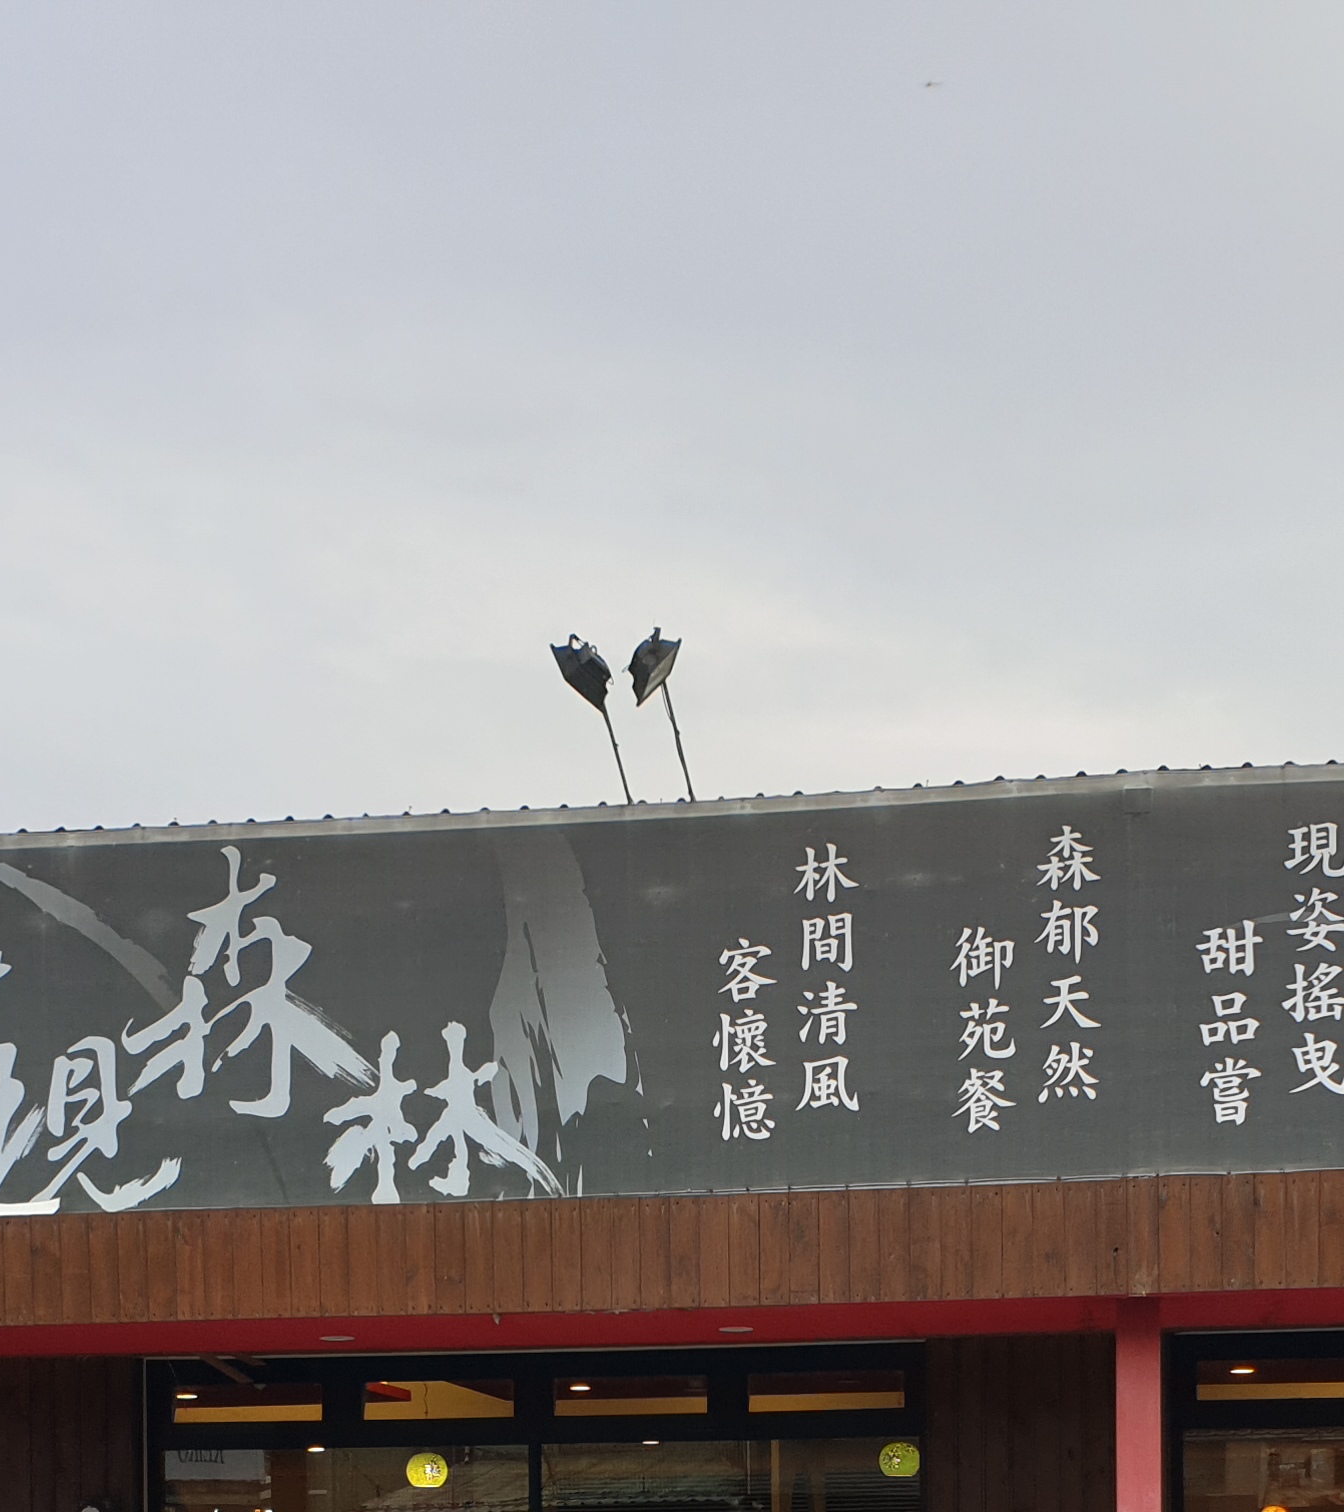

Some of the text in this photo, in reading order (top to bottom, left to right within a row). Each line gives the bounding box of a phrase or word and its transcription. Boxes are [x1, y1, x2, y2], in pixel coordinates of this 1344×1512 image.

[712, 938, 777, 1141] 客懷憶
[794, 843, 860, 1111] 林間清風
[950, 926, 1016, 1134] 御苑餐
[1034, 825, 1102, 1103] 森郁天然
[1195, 919, 1263, 1126] 甜品嘗
